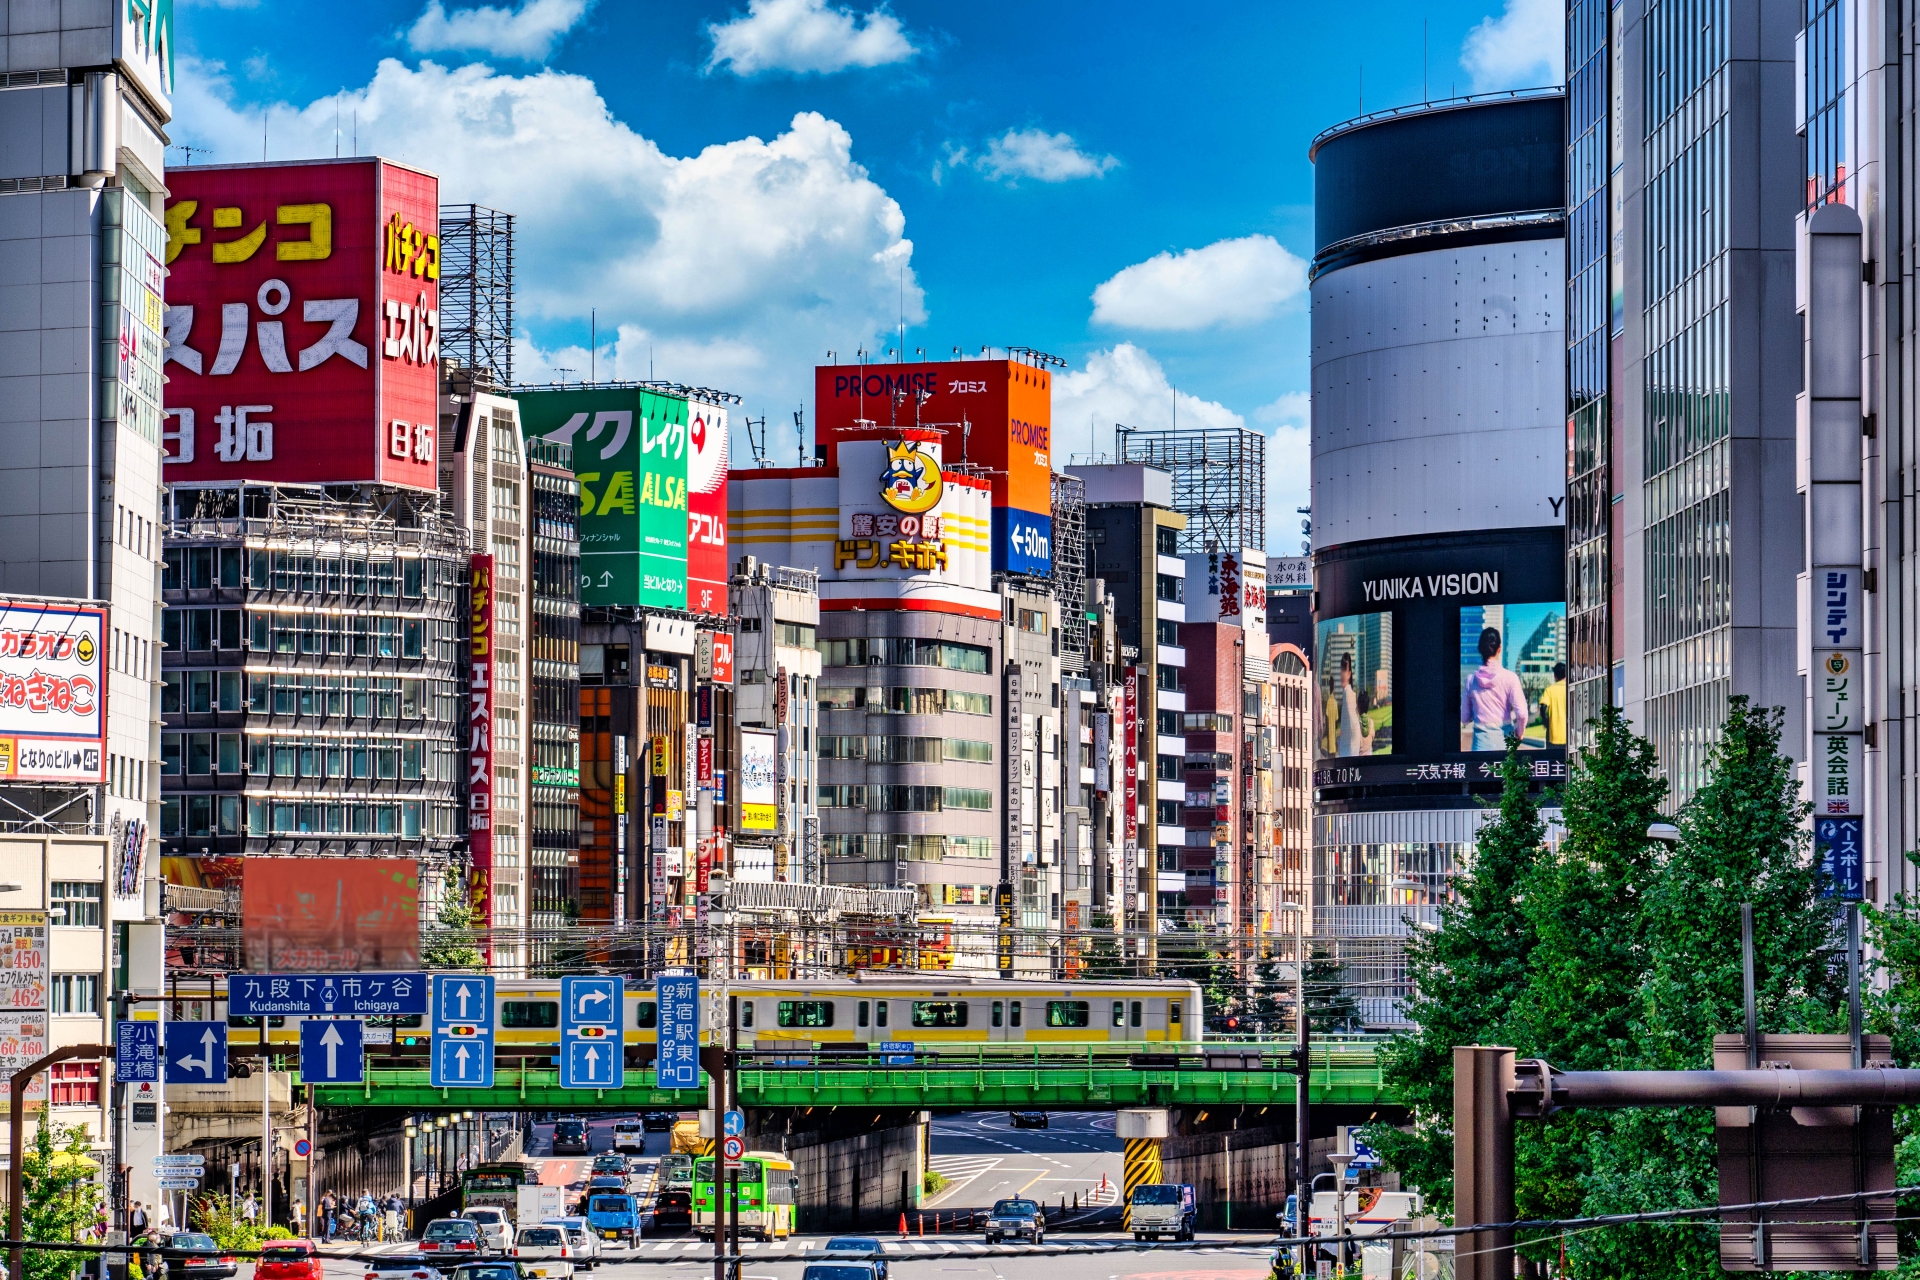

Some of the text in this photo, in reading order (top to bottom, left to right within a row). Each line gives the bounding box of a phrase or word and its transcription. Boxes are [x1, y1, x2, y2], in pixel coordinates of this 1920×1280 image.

[386, 211, 438, 280] パチンコ
[385, 290, 438, 366] エスパス
[835, 372, 937, 397] PROMISE
[948, 380, 988, 394] プロミス
[391, 418, 433, 463] 日拓
[642, 416, 685, 460] レイク
[1011, 418, 1048, 451] PROMISE
[640, 471, 686, 511] ALSA
[688, 511, 725, 547] アコム
[1024, 526, 1049, 561] 50m
[1276, 561, 1307, 572] 水の森
[701, 590, 713, 609] 3F
[1363, 571, 1499, 602] YUNIKA VISION
[472, 566, 489, 656] パチンコ
[1, 631, 75, 657] カラオケ
[700, 637, 709, 674] 戸谷ビル
[0, 671, 97, 714] ねきねこ
[1010, 679, 1018, 723] 6年4組
[471, 662, 489, 786] エスパス
[1125, 675, 1136, 798] カラオケ パセラ
[20, 748, 72, 769] となりのビル
[84, 750, 98, 771] 4F
[700, 748, 708, 780] アイフル
[470, 793, 489, 830] 日拓
[1010, 788, 1018, 832] 北の家族
[1840, 821, 1858, 891] ベースボール
[14, 927, 44, 937] 日高屋
[14, 951, 40, 968] 450
[12, 988, 40, 1007] 462
[244, 979, 316, 999] 九段下
[324, 989, 333, 1000] 4
[250, 1000, 400, 1012] Kudanshita Ichigaya
[660, 985, 675, 1035] Shinjuku
[21, 1042, 42, 1055] 460
[676, 982, 694, 1082] 新宿駅東口
[119, 1025, 134, 1079] Otakibashi Brdg.
[135, 1025, 155, 1078] 小滝橋
